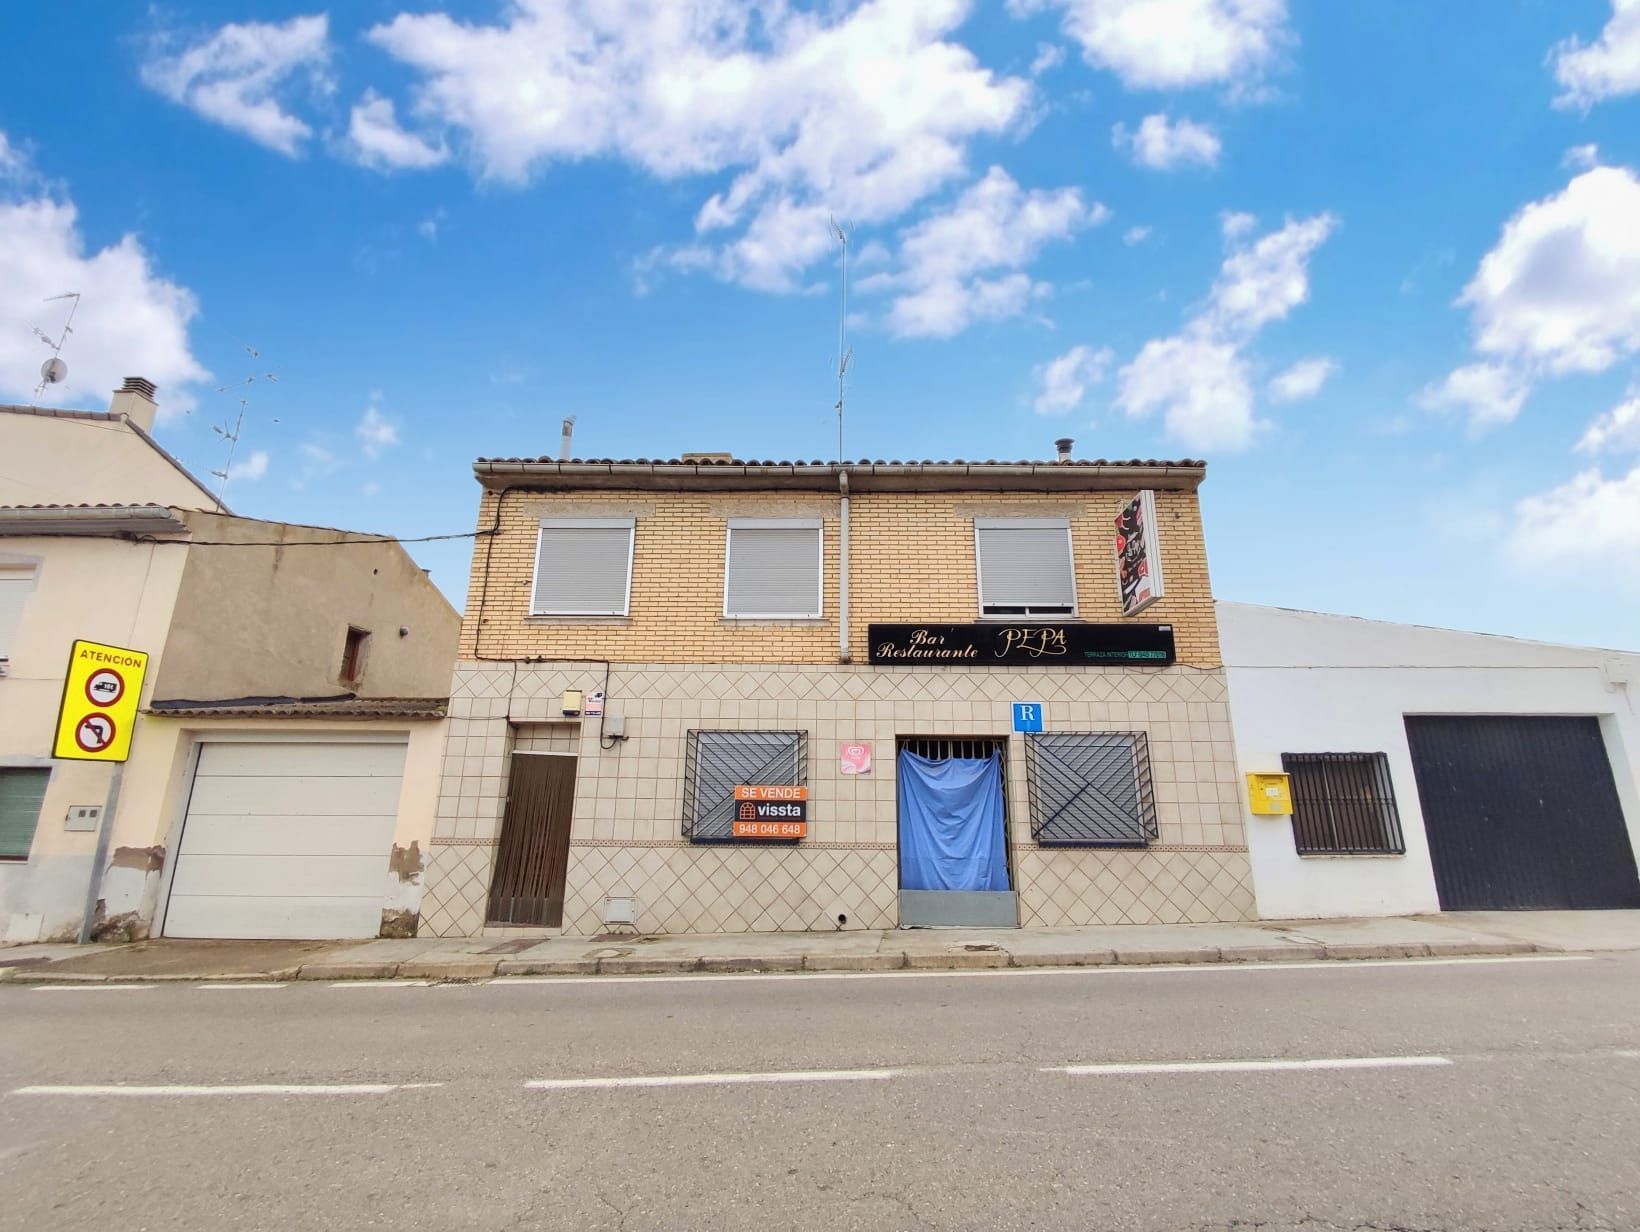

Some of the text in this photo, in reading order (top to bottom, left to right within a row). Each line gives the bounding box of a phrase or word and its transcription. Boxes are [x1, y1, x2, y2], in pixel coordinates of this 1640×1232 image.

[910, 629, 945, 645] Bar
[994, 628, 1067, 658] PEPA
[876, 642, 979, 658] Restaurante
[1020, 705, 1036, 721] R
[741, 787, 801, 799] SE VENDE
[757, 803, 801, 816] vissta
[739, 824, 801, 834] 948 046 648
